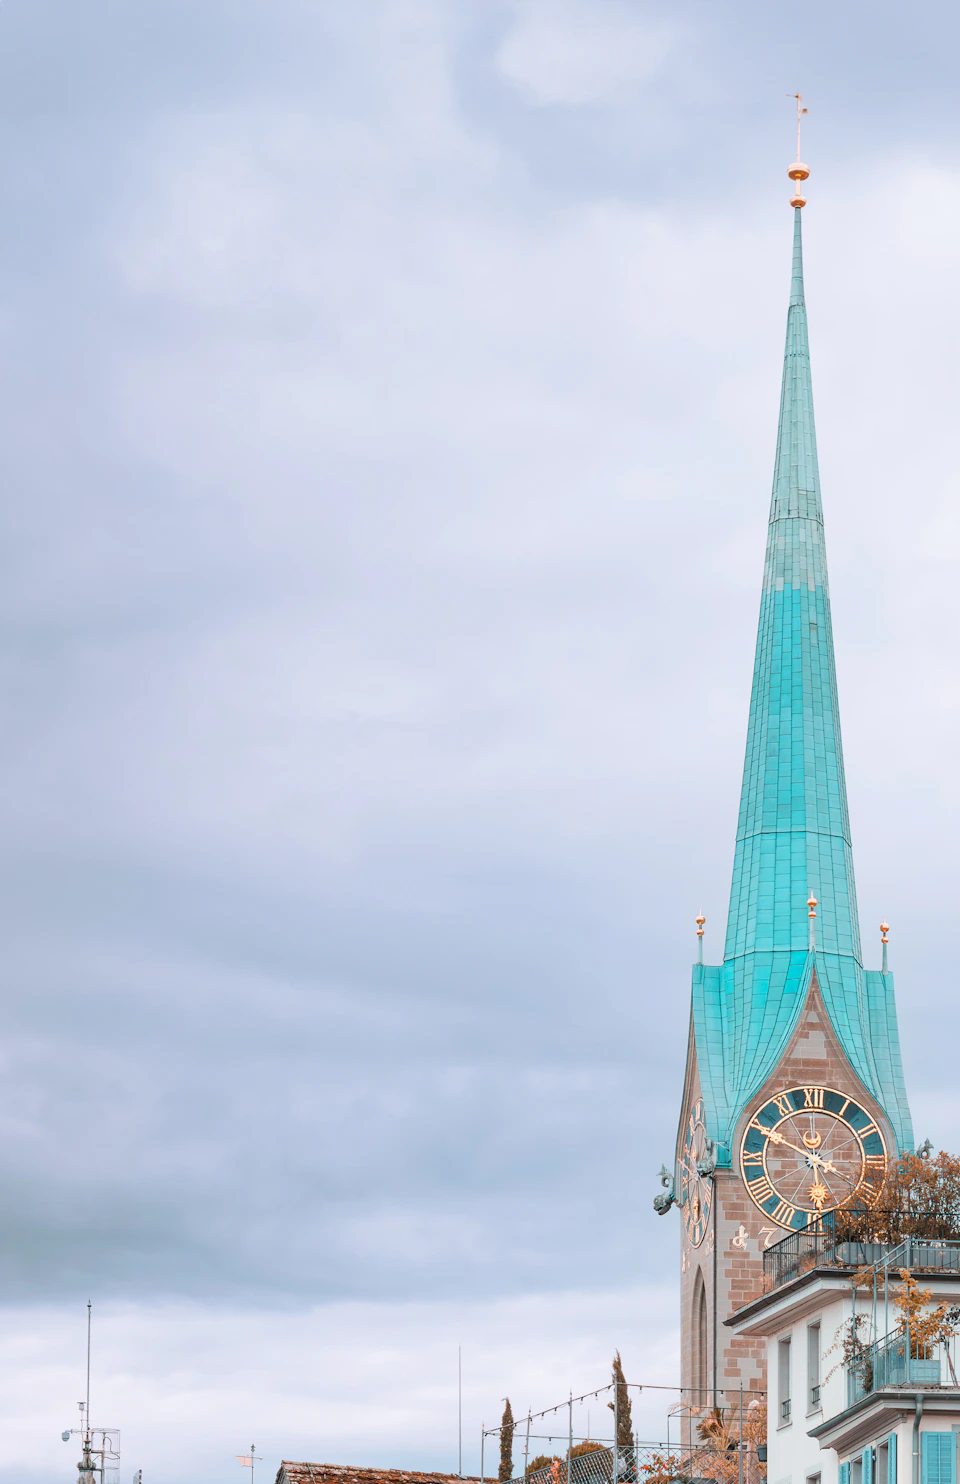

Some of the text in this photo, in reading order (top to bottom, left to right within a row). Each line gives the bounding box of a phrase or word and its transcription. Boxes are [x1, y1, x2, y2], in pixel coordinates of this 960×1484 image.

[773, 1095, 794, 1117] XI
[803, 1088, 825, 1109] XII
[838, 1099, 851, 1117] I
[857, 1123, 878, 1139] II
[743, 1150, 763, 1167] IX
